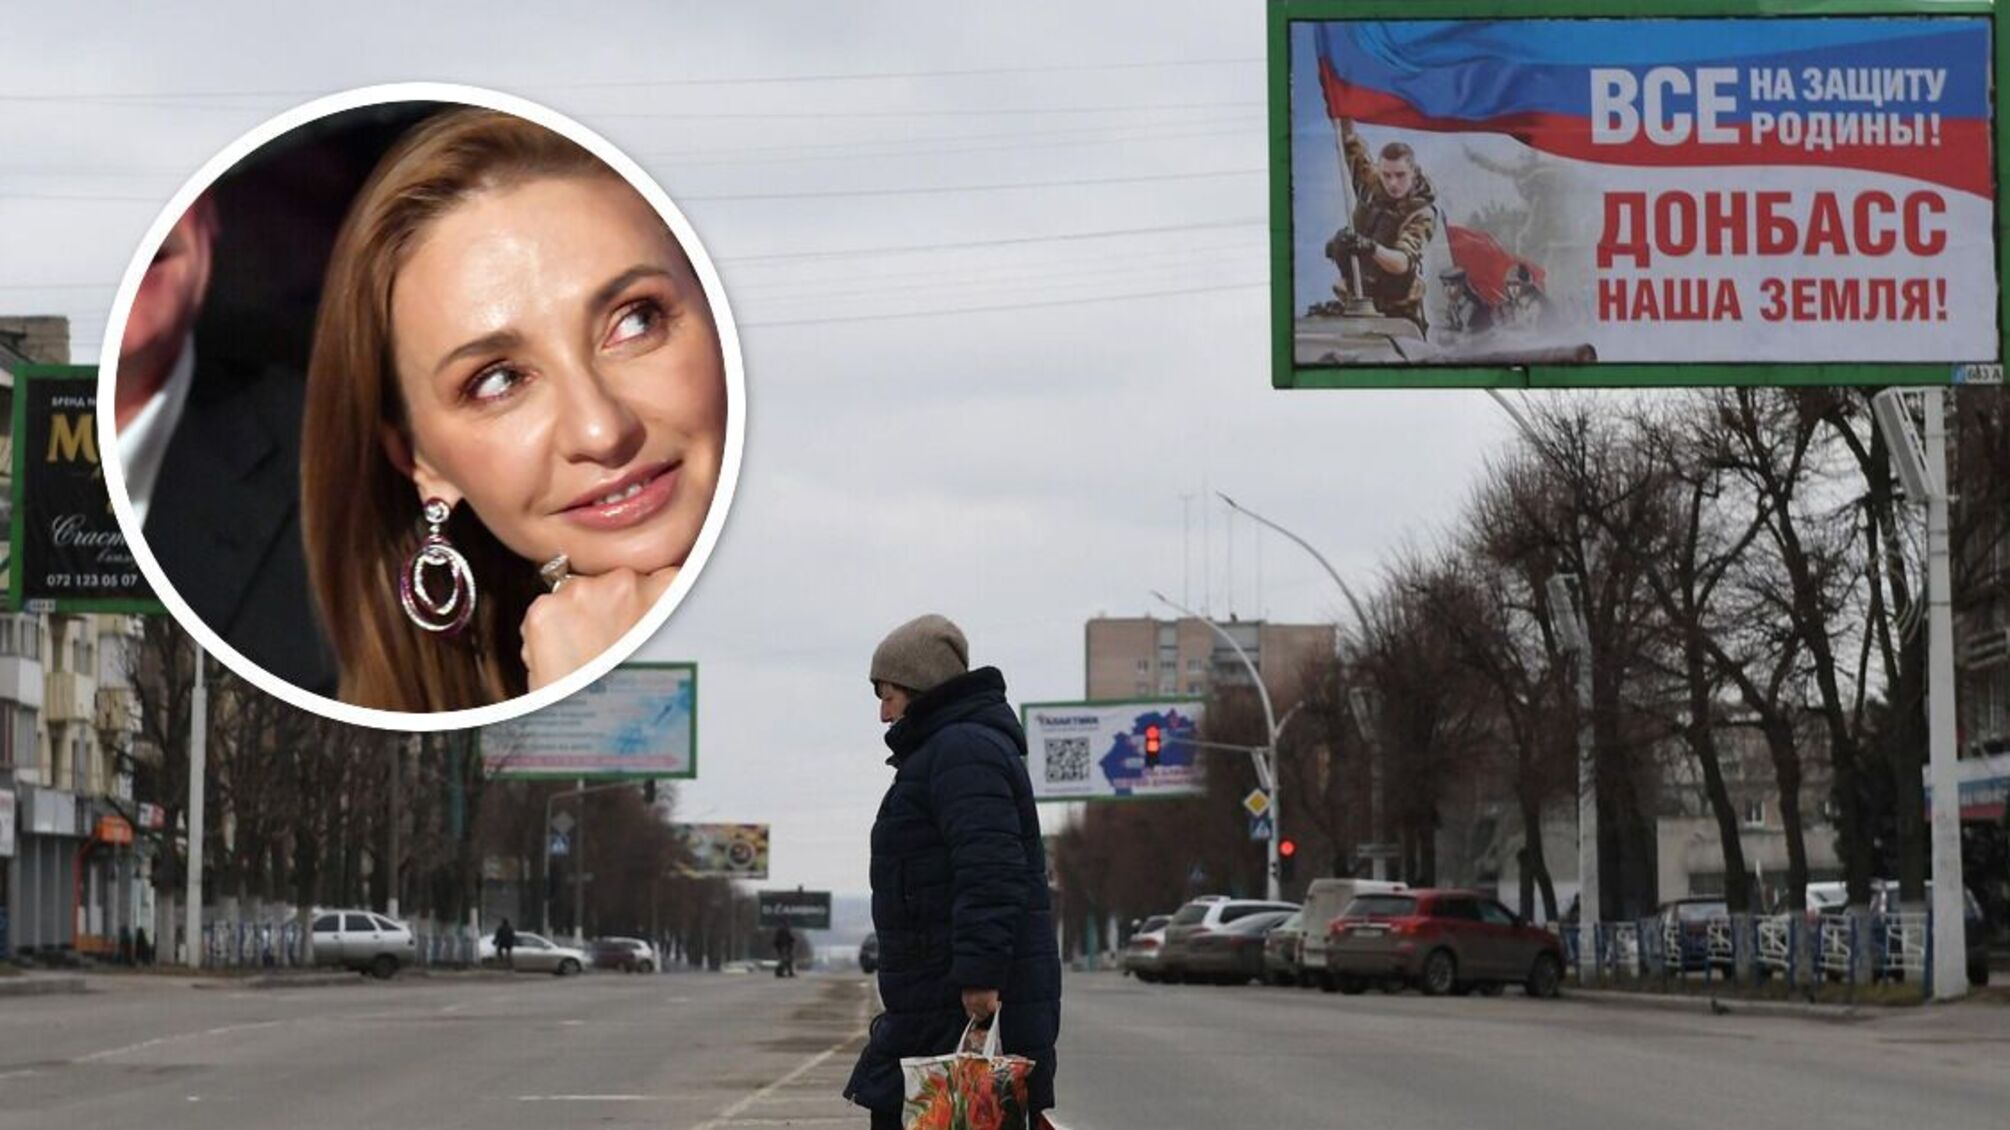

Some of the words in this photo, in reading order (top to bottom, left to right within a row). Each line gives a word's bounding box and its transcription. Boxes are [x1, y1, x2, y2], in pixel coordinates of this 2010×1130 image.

[1590, 67, 1740, 146] ВСЕ
[1750, 68, 1796, 101] НА
[1803, 67, 1947, 107] ЗАЩИТУ
[1751, 112, 1942, 151] РОДИНЫ!
[1596, 190, 1948, 268] ДОНБАСС
[1598, 278, 1744, 322] НАША
[1759, 277, 1949, 322] ЗЕМЛЯ!
[47, 573, 71, 587] 072
[76, 573, 98, 587] 123
[120, 573, 138, 587] 07
